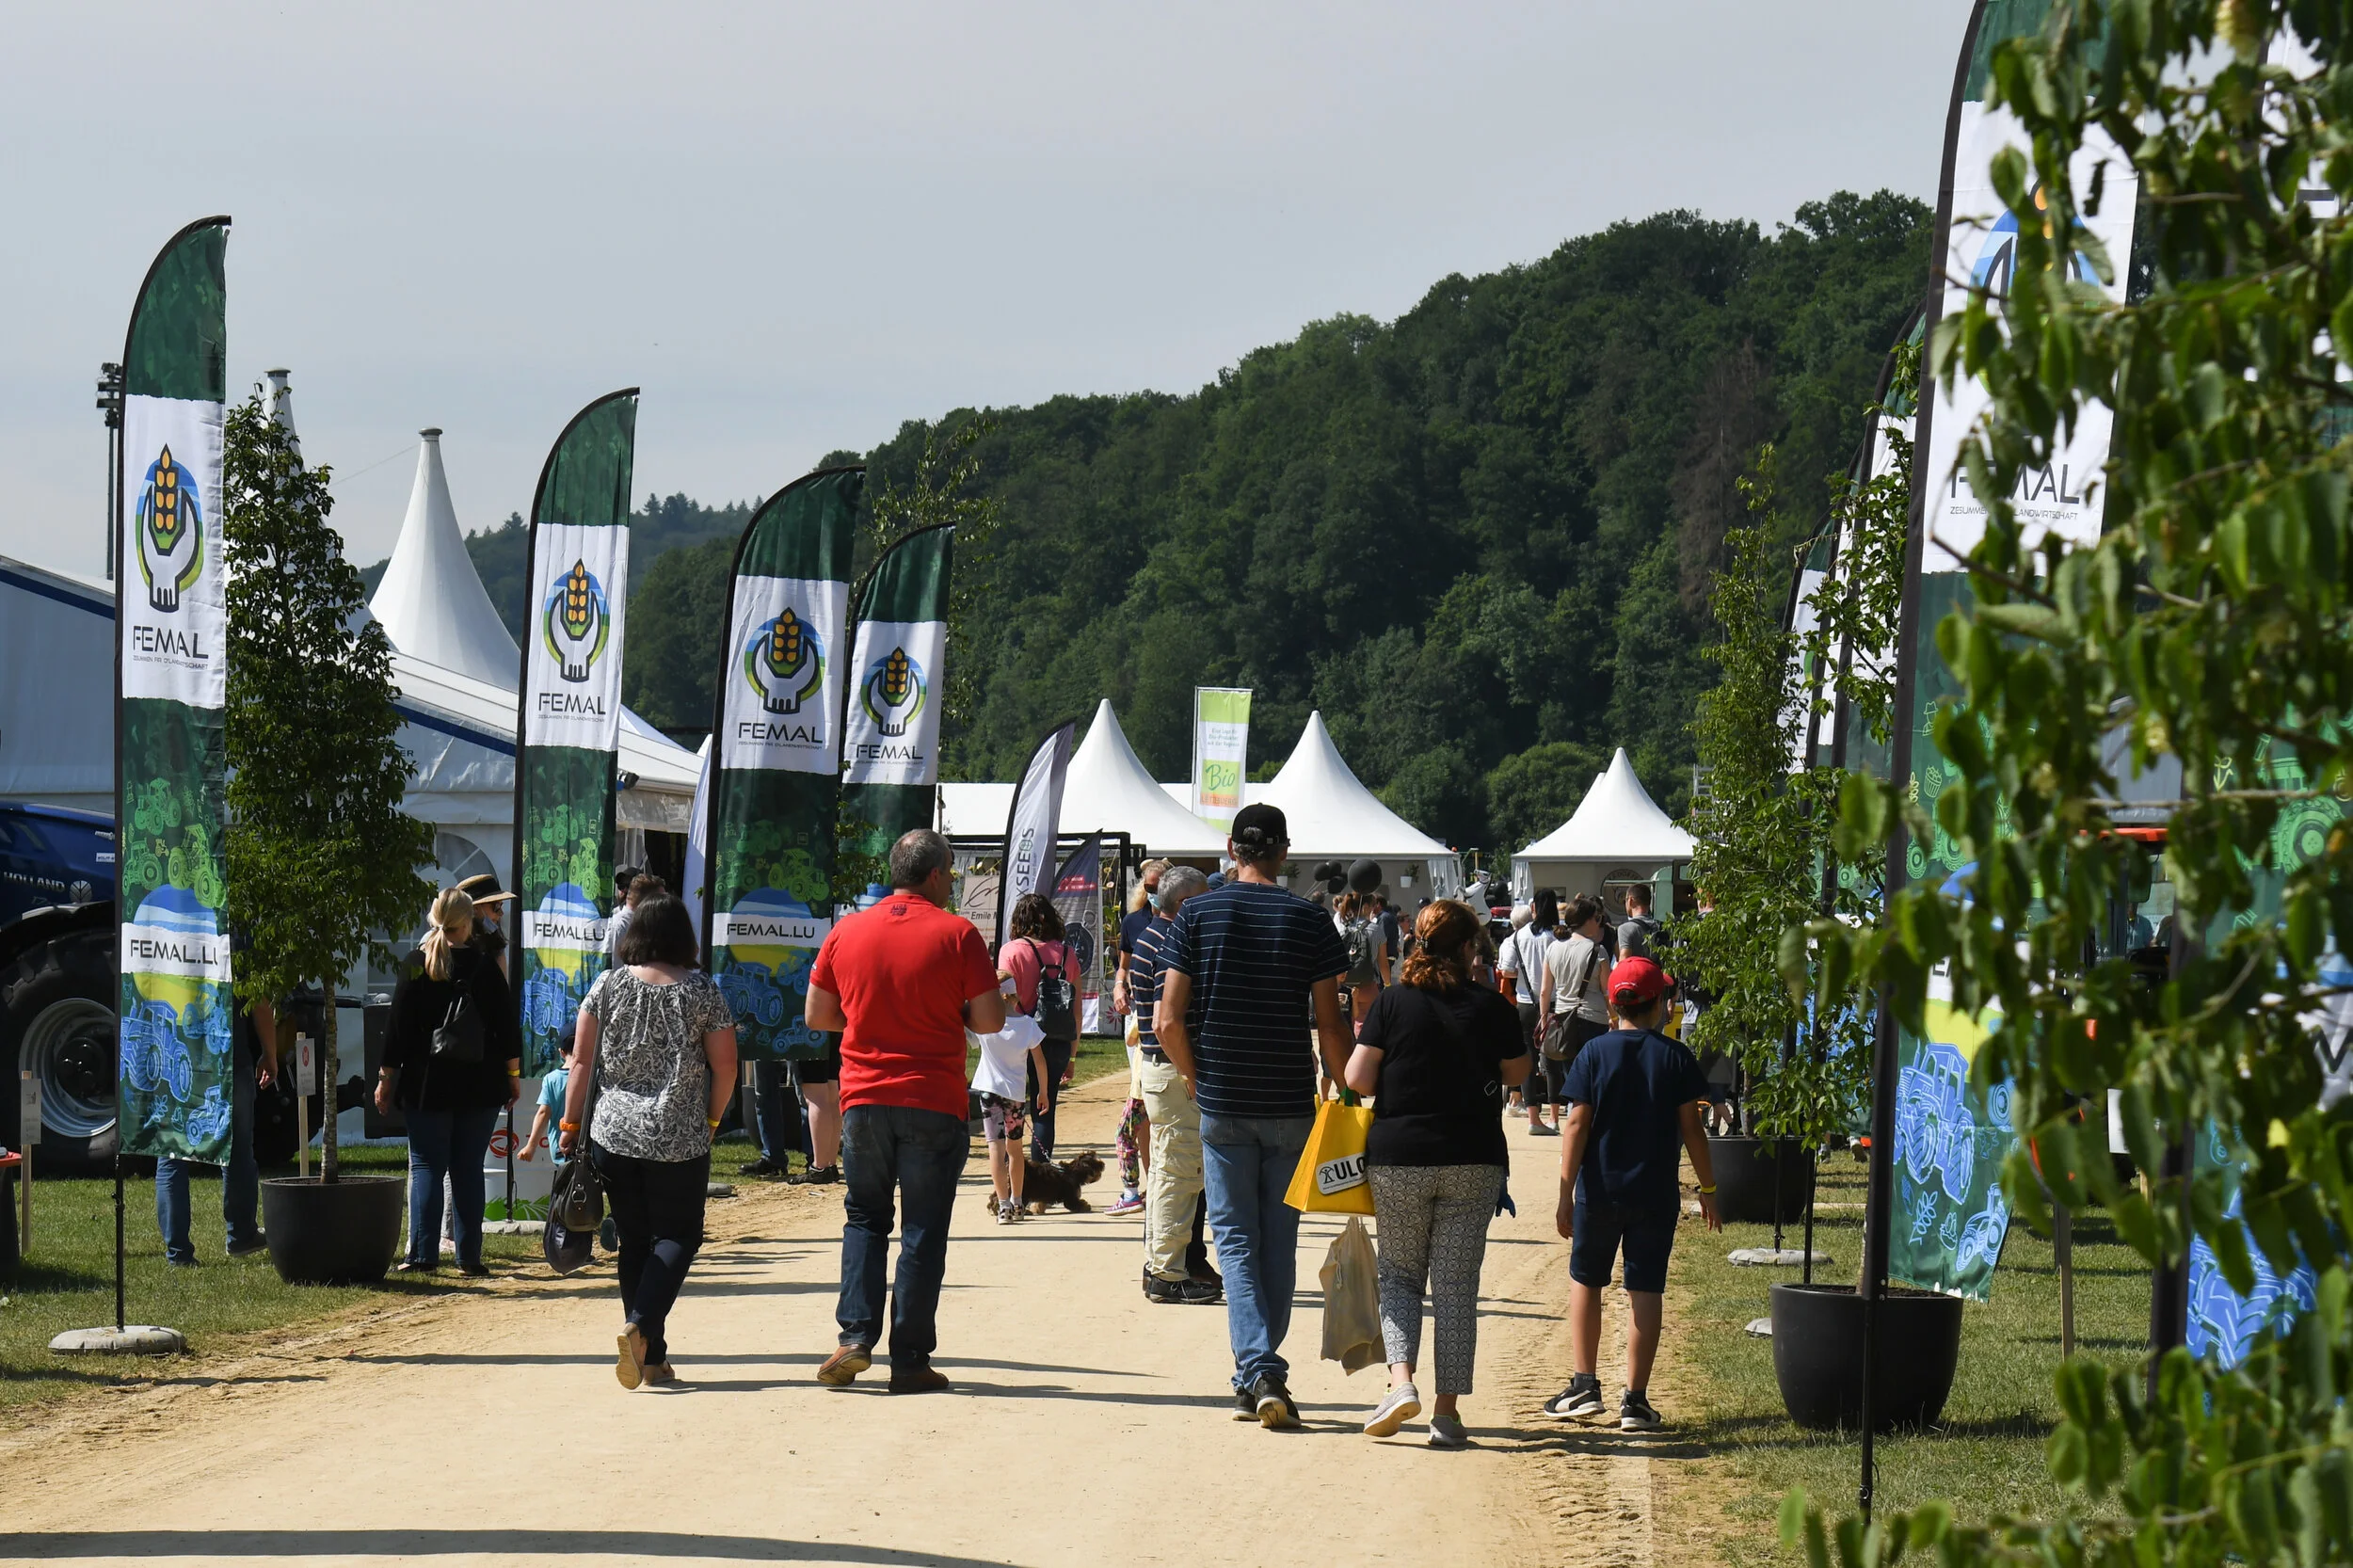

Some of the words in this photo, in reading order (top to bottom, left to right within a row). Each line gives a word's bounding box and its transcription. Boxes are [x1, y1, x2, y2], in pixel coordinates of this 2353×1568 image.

[1951, 460, 2080, 504] FMAL
[1950, 506, 1988, 515] ZESUMME
[2014, 508, 2078, 520] ANDWIRTSCHAFT
[134, 625, 209, 659] FEMAL
[538, 693, 606, 715] FEMAL
[739, 723, 823, 744] FEMAL
[856, 744, 923, 760] FEMAL
[1206, 763, 1236, 791] Bio
[3, 872, 66, 892] HOLLAND
[971, 911, 992, 920] Emile
[727, 923, 815, 938] FEMAL.LU
